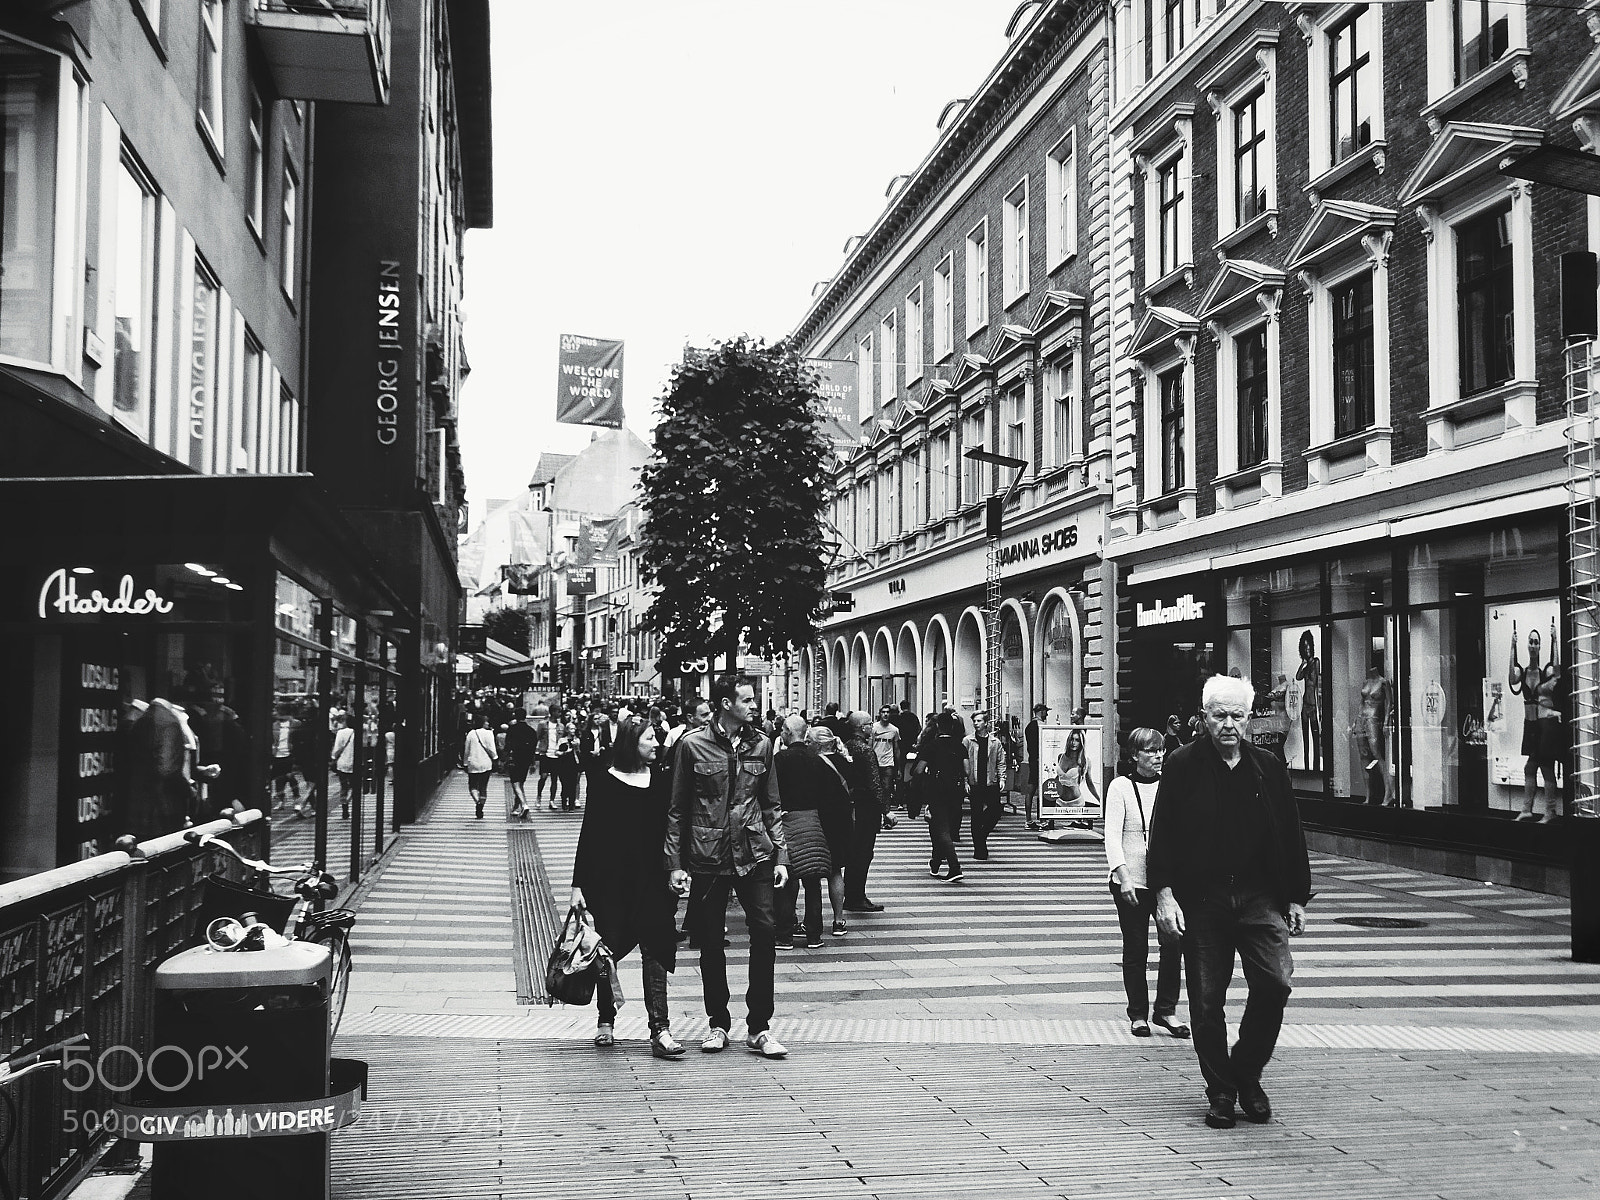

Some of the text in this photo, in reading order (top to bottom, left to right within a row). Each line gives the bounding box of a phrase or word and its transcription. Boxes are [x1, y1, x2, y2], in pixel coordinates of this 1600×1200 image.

[376, 260, 403, 445] GEORG JENSEN
[562, 365, 620, 378] WELCOME
[580, 377, 602, 387] THE
[817, 384, 852, 393] ORLD OF
[569, 386, 612, 399] WORLD
[817, 391, 846, 400] ULTURE
[824, 406, 843, 415] YEAR
[1041, 525, 1078, 555] SHOES
[38, 568, 174, 618] Harder
[139, 1105, 335, 1135] GIV VIDERE
